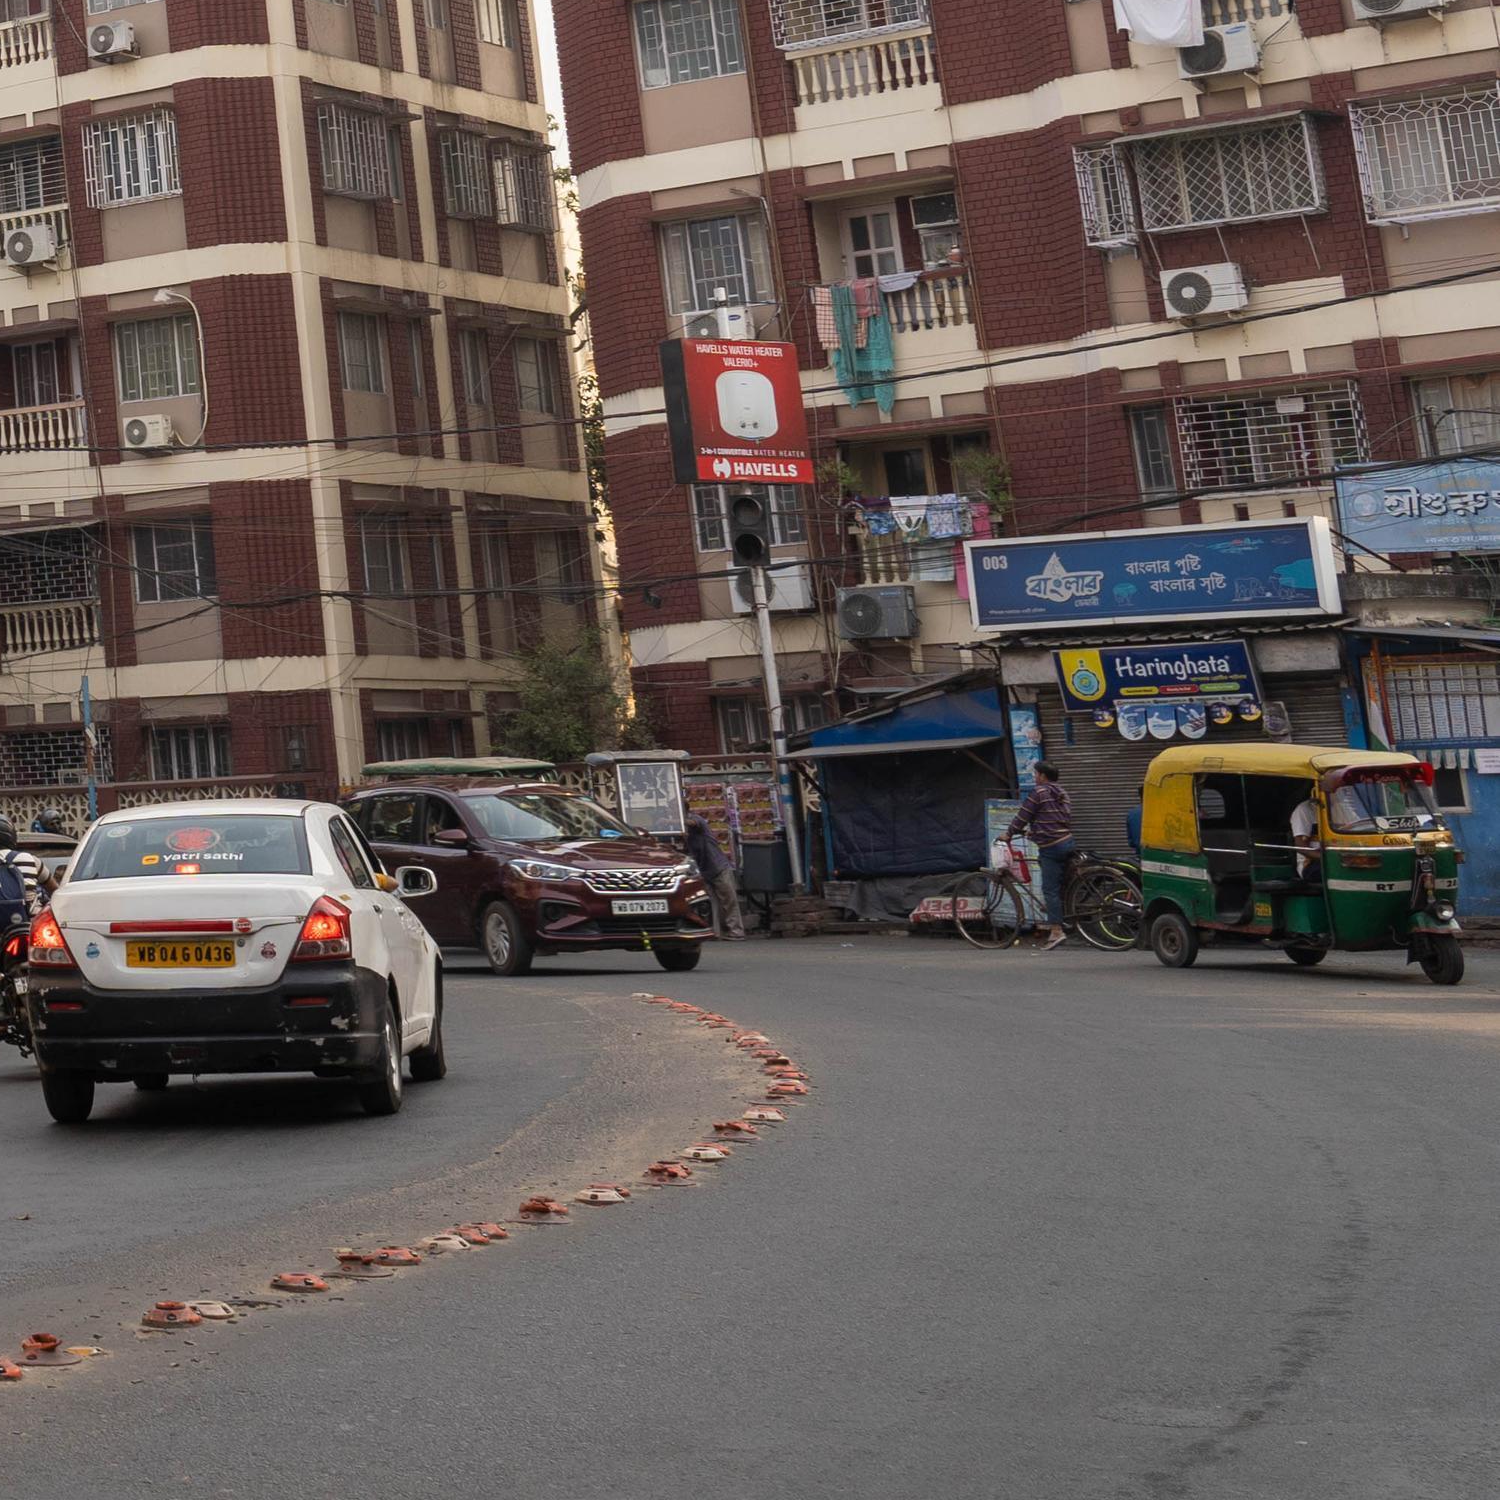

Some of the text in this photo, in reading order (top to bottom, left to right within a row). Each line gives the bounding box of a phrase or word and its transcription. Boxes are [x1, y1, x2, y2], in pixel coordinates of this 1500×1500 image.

[696, 344, 783, 357] HAVELLS WATER HEATER
[754, 449, 776, 457] WATER
[779, 450, 805, 458] HEATER
[733, 462, 798, 477] HAVELLS
[983, 556, 1008, 570] 003
[1125, 553, 1201, 576] বাংলার পুষ্টি
[1149, 572, 1227, 596] বাংলার সৃষ্টি
[1115, 654, 1230, 680] Haringhata
[163, 852, 243, 862] yatri sathi
[1376, 883, 1395, 891] RT
[138, 946, 156, 962] WB
[160, 946, 178, 962] 04
[195, 946, 232, 962] 0436
